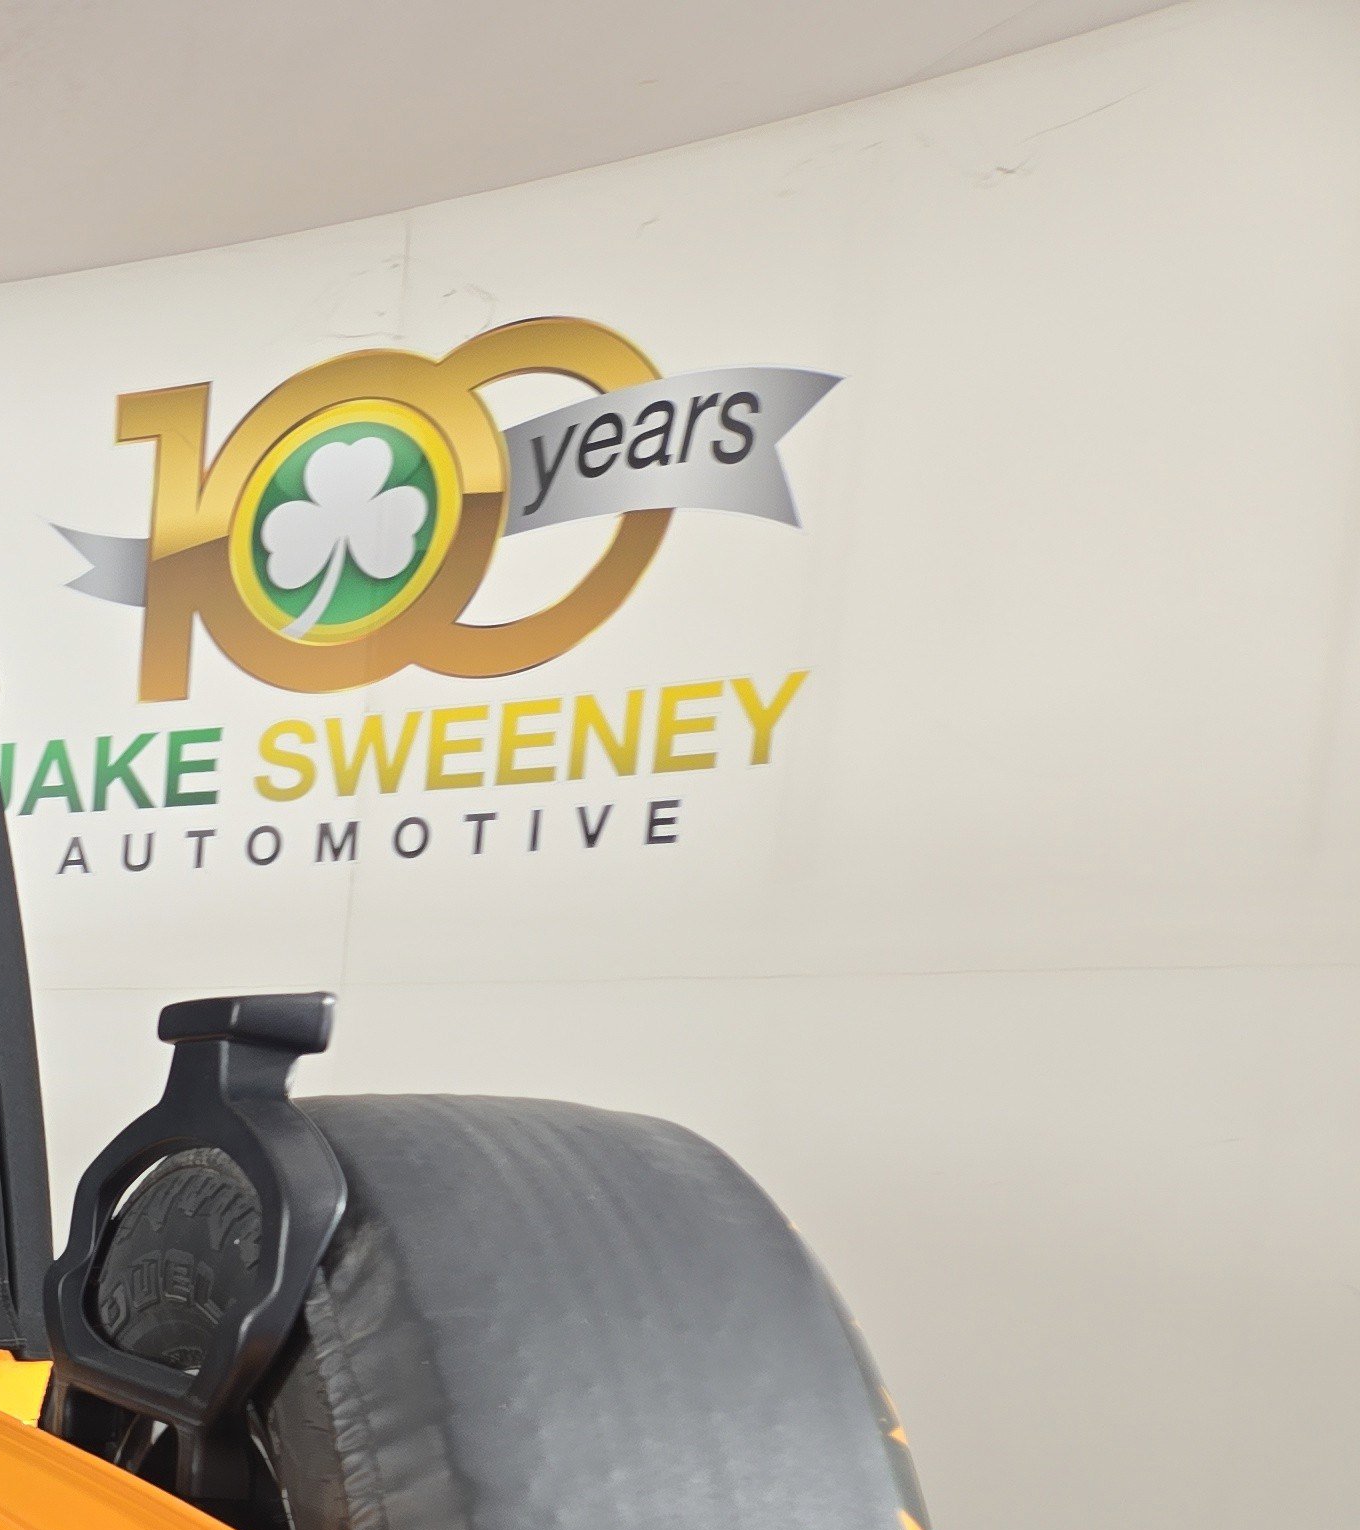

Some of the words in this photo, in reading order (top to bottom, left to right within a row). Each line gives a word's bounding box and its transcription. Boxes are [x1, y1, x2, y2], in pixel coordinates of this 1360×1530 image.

[522, 389, 761, 517] years
[254, 671, 809, 803] SWEENEY
[56, 800, 680, 876] AUTOMOTIVE
